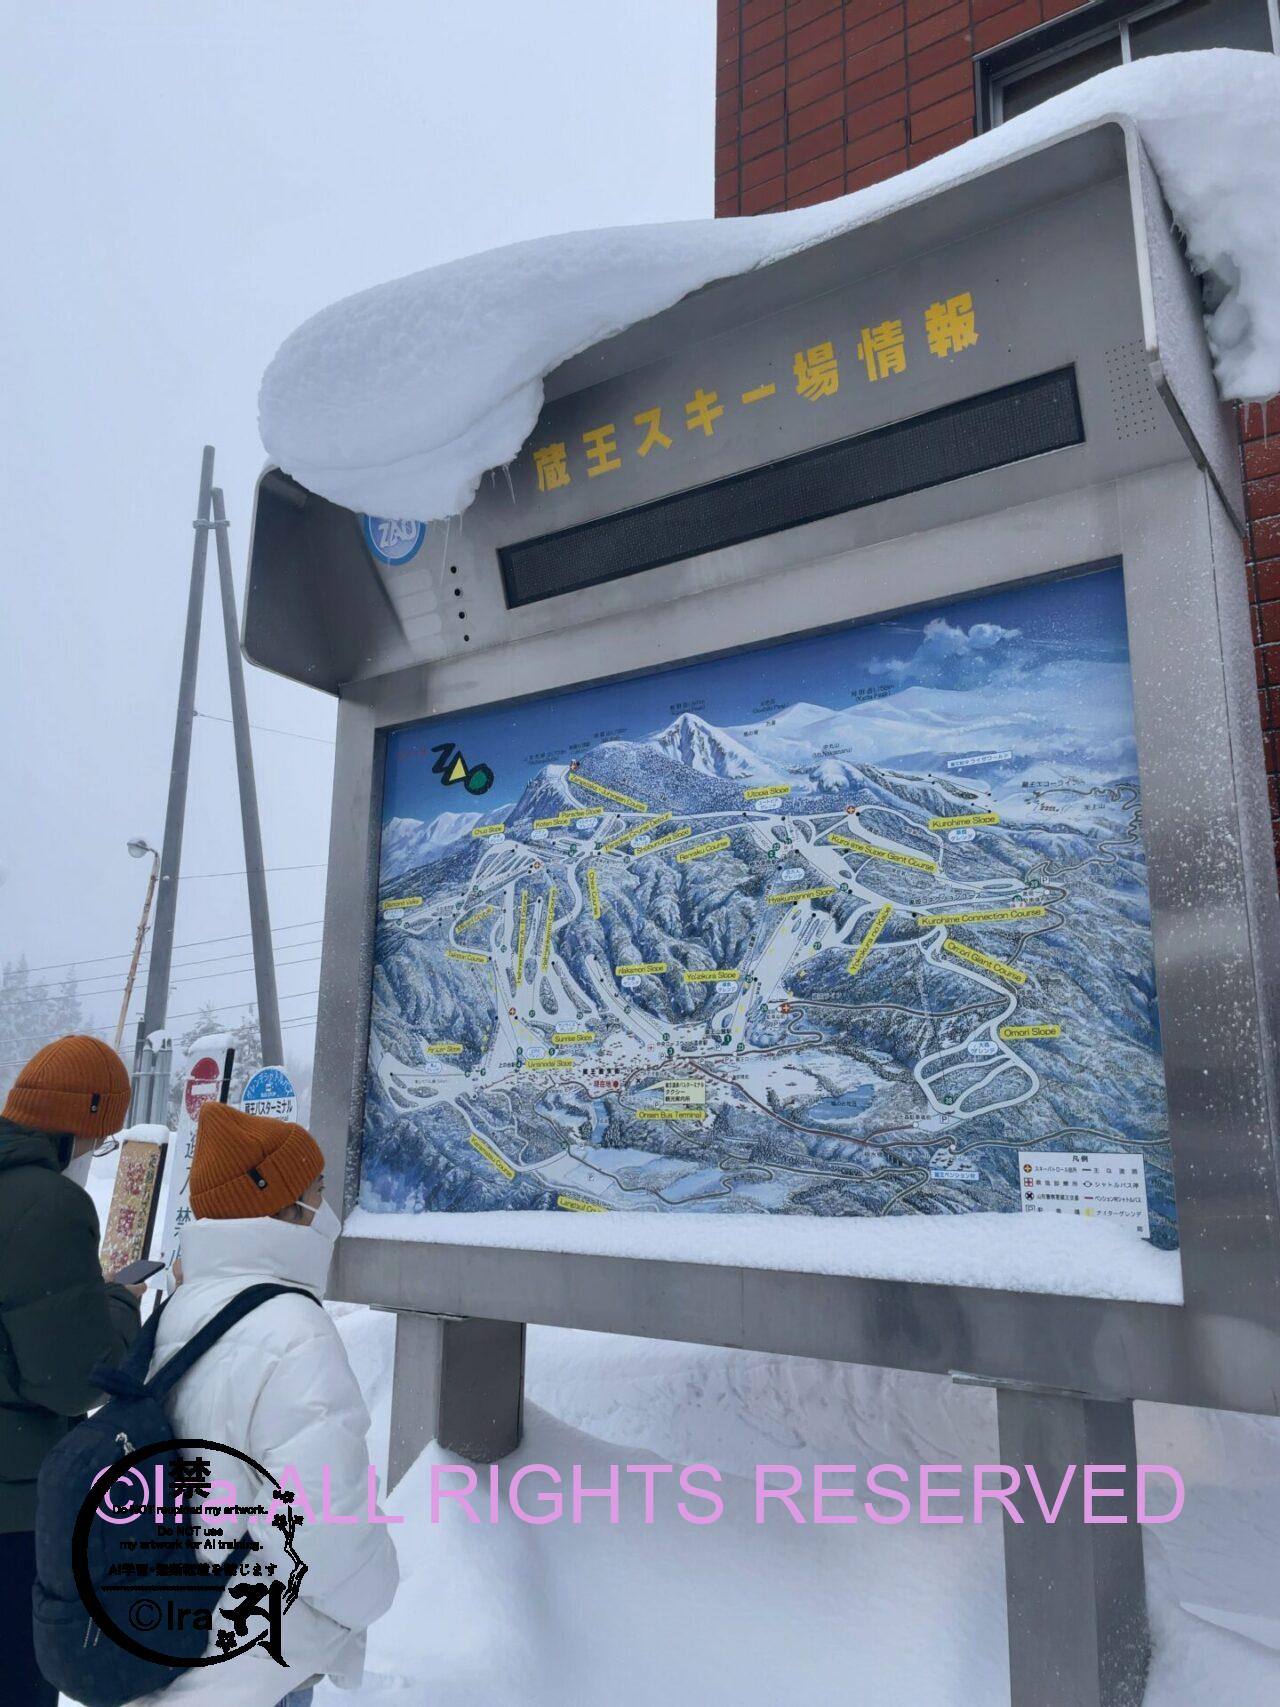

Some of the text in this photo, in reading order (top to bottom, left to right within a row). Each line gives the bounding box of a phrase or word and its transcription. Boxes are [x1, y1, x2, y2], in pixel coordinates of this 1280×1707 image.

[532, 291, 979, 493] 蔵王スキー場情報
[430, 742, 494, 795] ZAO
[771, 786, 790, 796] Slope
[932, 815, 996, 829] Kurohime Slope
[864, 844, 886, 858] Super
[886, 851, 906, 865] Giant
[907, 857, 934, 871] Course
[921, 908, 1041, 925] Kurohime Connection Course
[947, 942, 1022, 982] Omori Giant Course
[719, 971, 736, 979] Slope
[1003, 1026, 1057, 1037] Omori Slope
[245, 1100, 293, 1116] 蔵王バスターミナル
[638, 1110, 702, 1119] Onsen Bus Terminal
